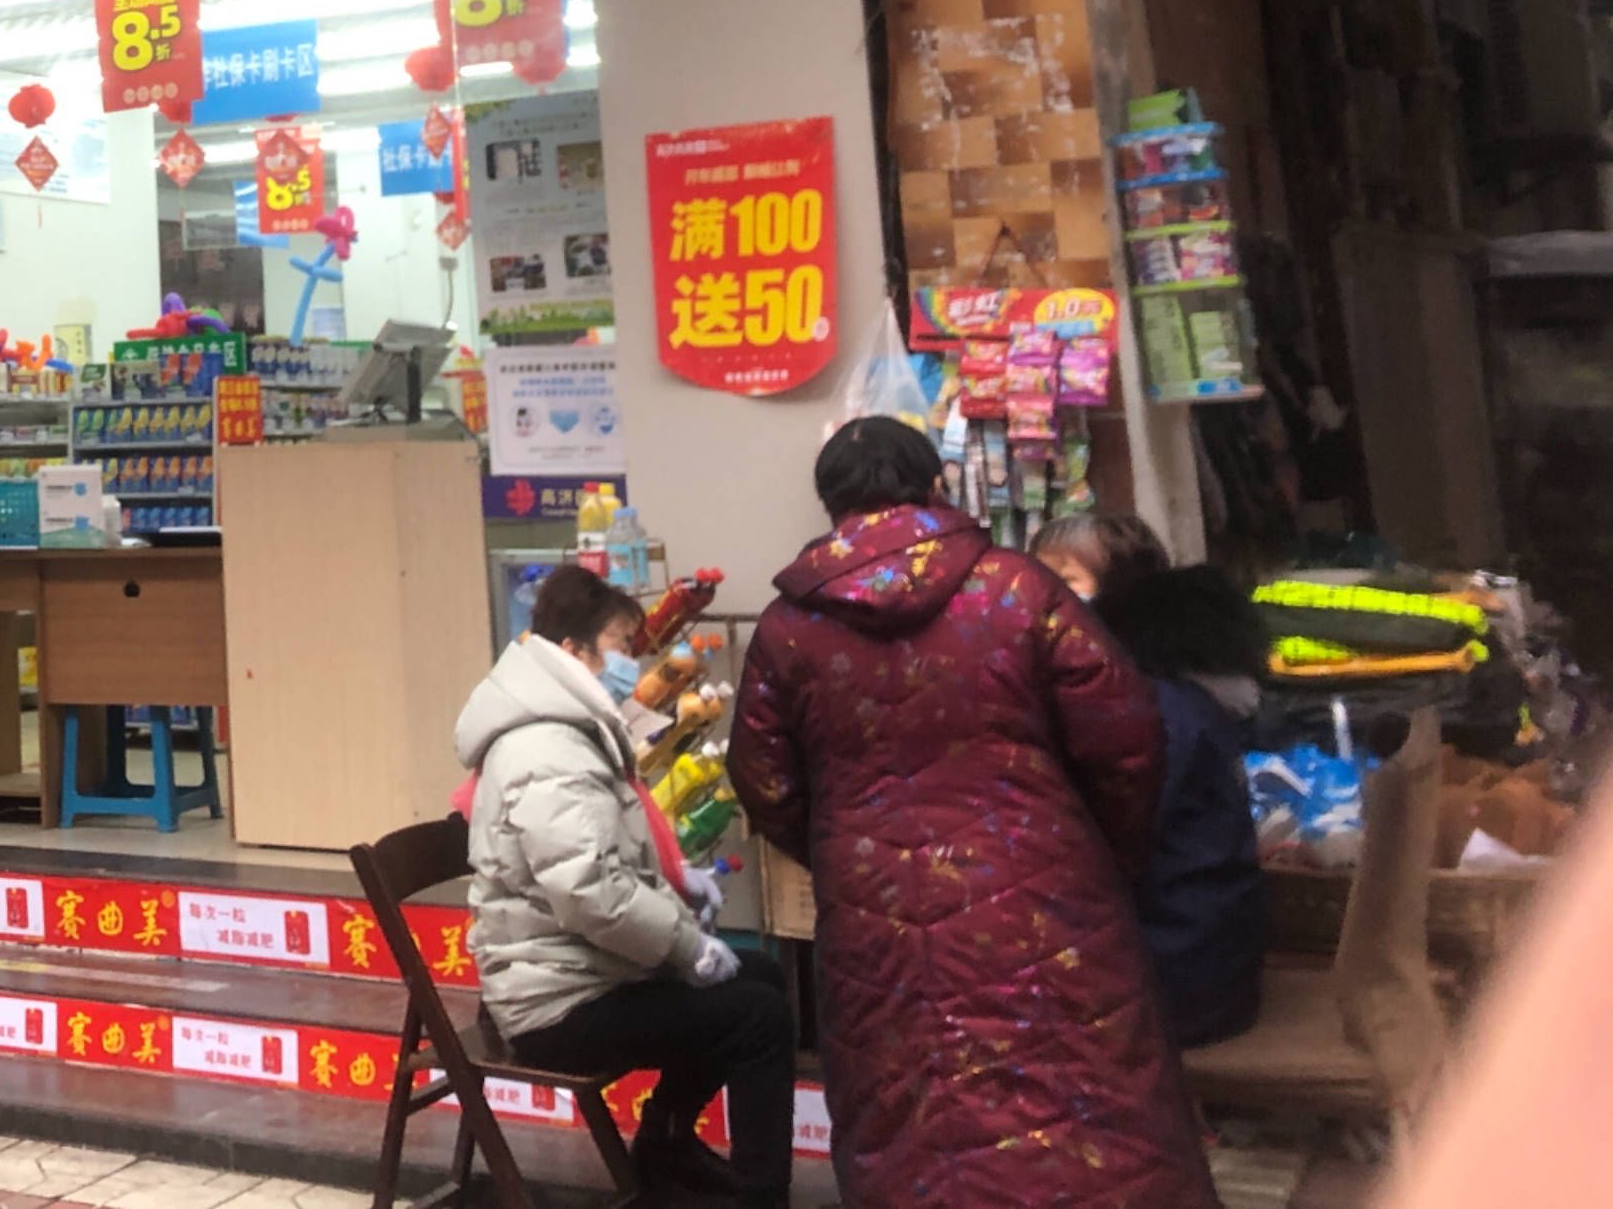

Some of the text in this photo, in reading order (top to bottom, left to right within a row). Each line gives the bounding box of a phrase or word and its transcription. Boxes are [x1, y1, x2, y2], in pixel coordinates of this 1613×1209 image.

[669, 189, 823, 261] 满100
[189, 903, 246, 923] 每次一粒
[217, 929, 274, 950] 减脂减肥
[342, 914, 472, 977] 赛美
[309, 1039, 395, 1089] 赛曲
